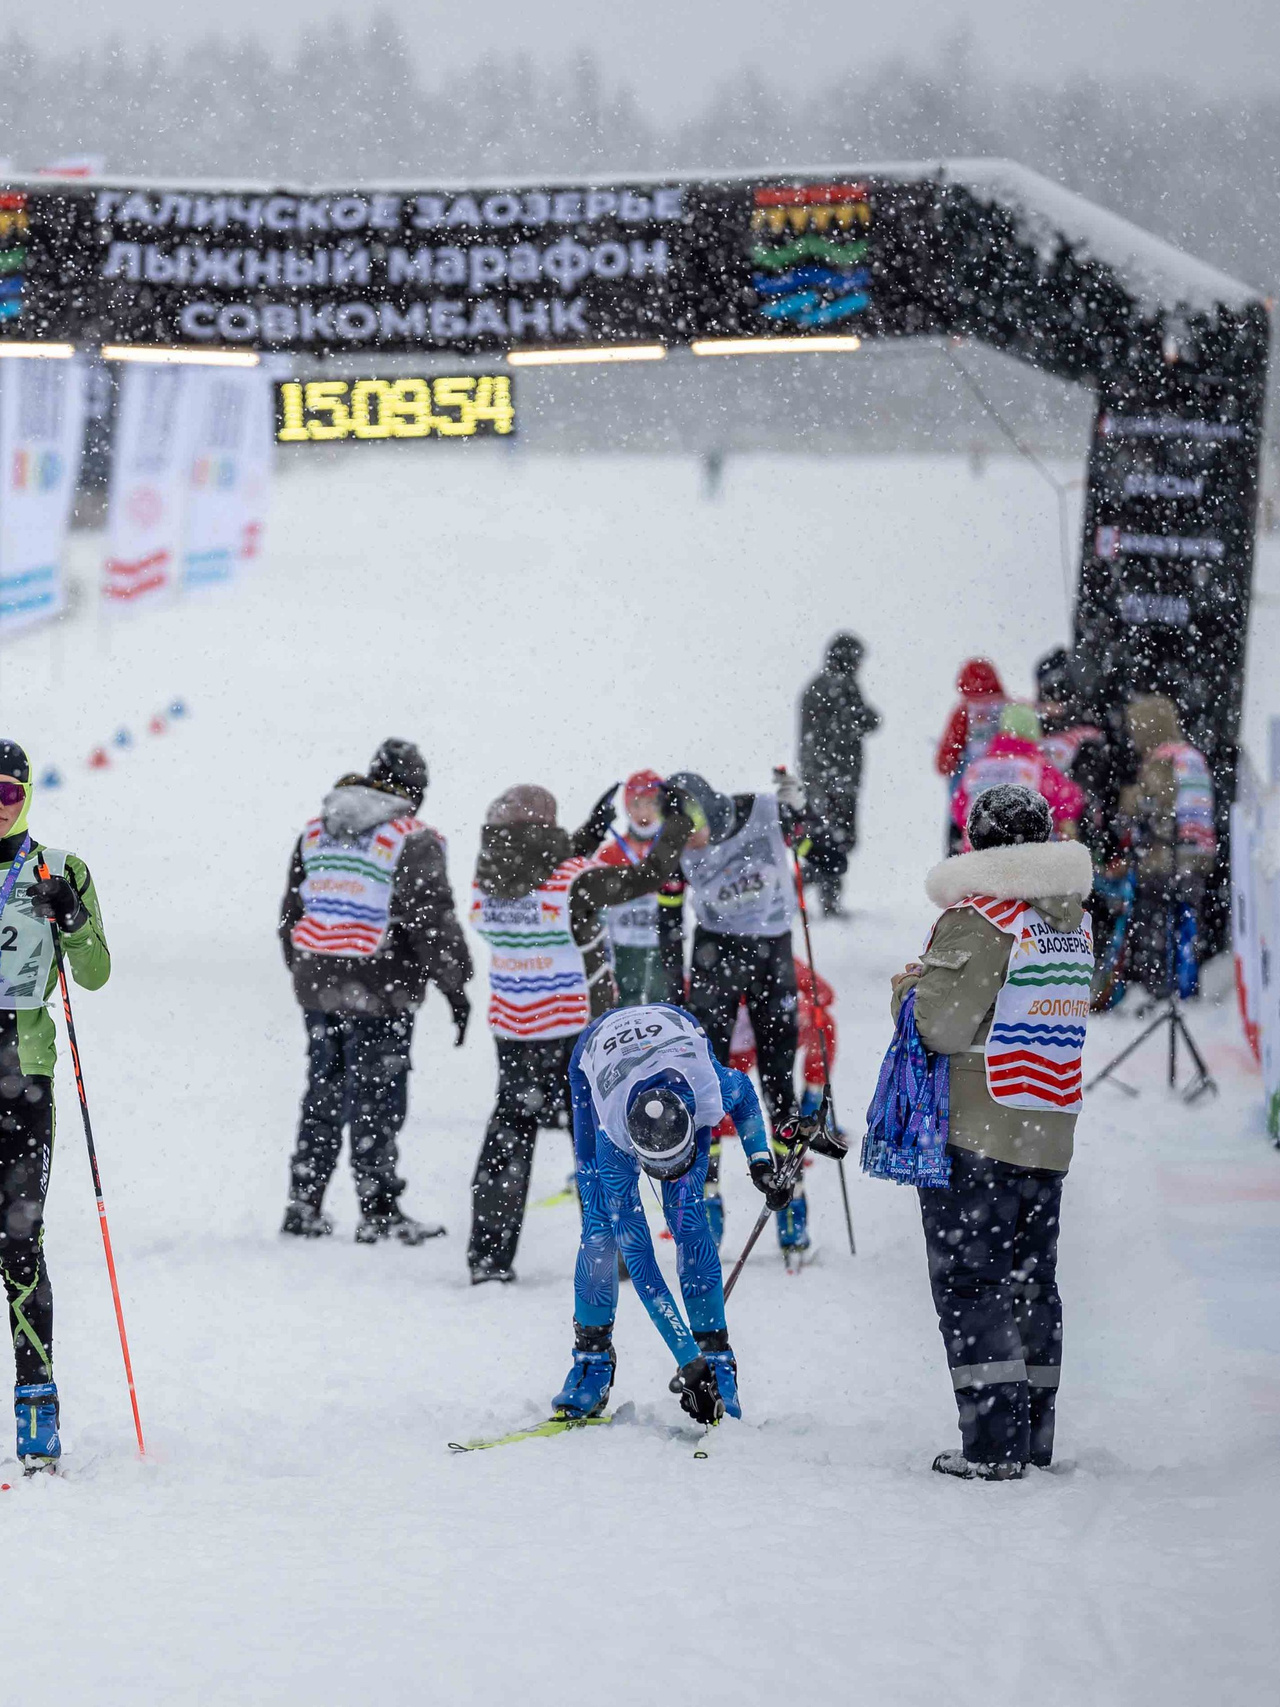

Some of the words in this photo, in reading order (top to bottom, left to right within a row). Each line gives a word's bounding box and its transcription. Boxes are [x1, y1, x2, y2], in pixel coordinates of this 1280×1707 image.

[97, 192, 400, 231] ГАЛИЧСКОЕ
[414, 188, 683, 229] ЗАОЗЕРЬЕ
[181, 298, 588, 341] СОВКОМБАНК
[718, 871, 764, 901] 6123
[1038, 937, 1092, 956] ЗАОЗЕРЬЕ
[603, 1024, 663, 1056] 6125
